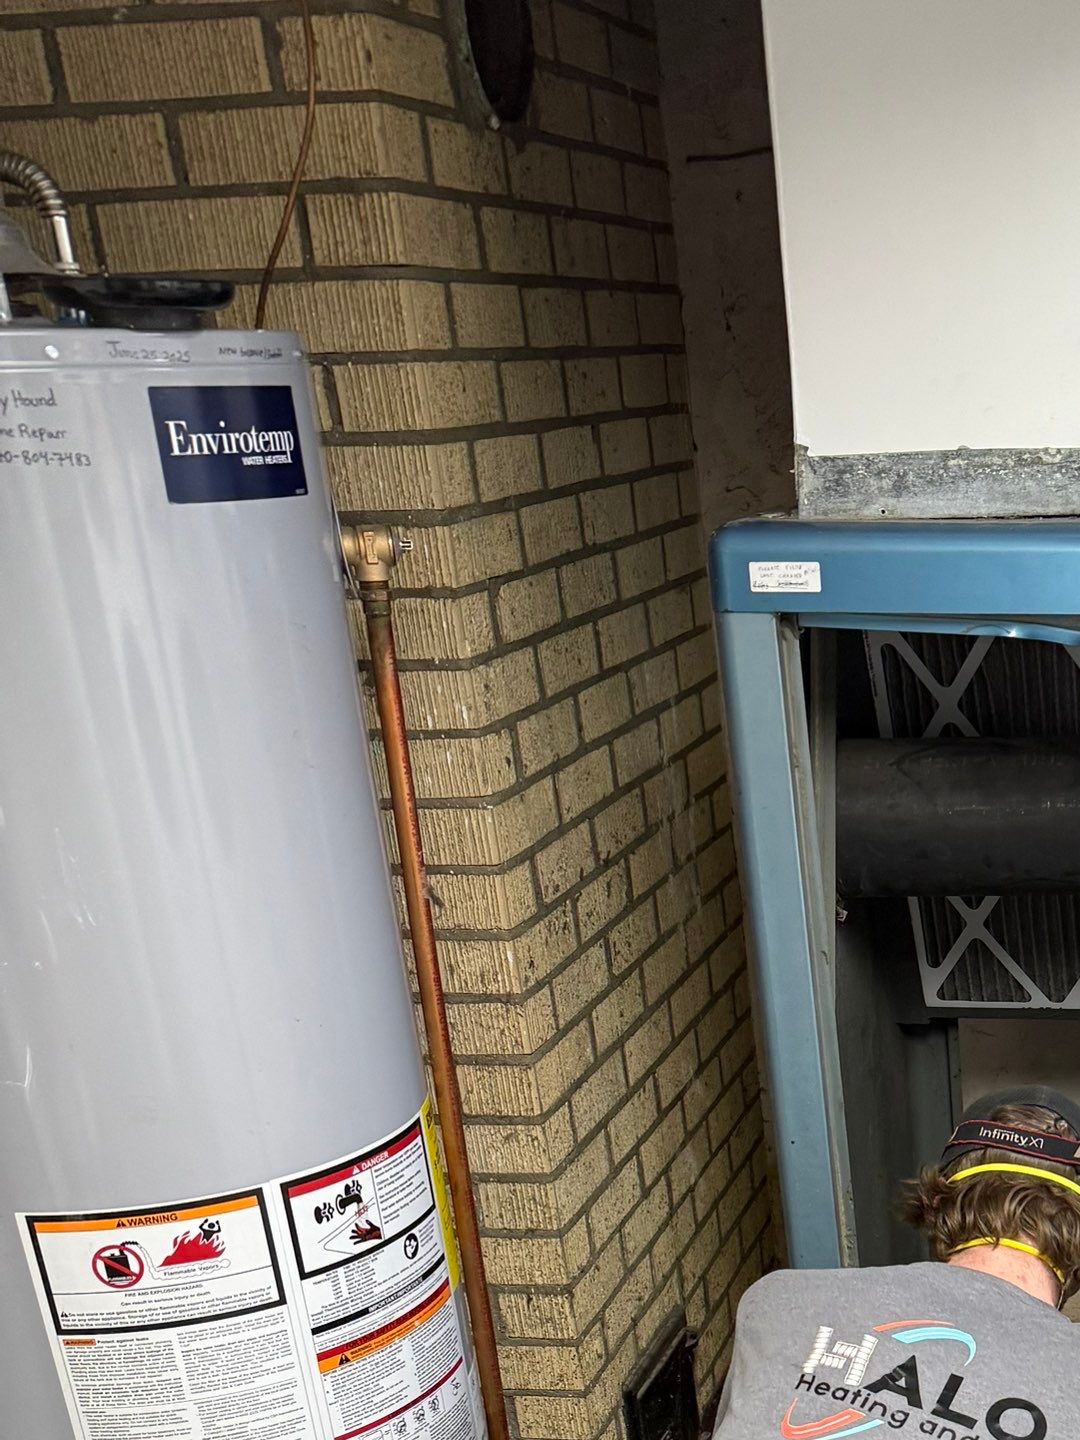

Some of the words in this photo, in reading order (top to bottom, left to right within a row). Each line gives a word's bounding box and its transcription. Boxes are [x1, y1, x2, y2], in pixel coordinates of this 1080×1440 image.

[11, 387, 58, 408] Hound
[165, 420, 295, 463] Envirotemp
[242, 456, 264, 466] WATER
[265, 455, 288, 464] HEATERS
[979, 1126, 1028, 1146] Infinity
[361, 1151, 390, 1172] DANGER
[127, 1213, 178, 1227] WARNING
[164, 1267, 196, 1276] Flammable
[198, 1264, 219, 1272] Vapors
[794, 1372, 911, 1430] Heating
